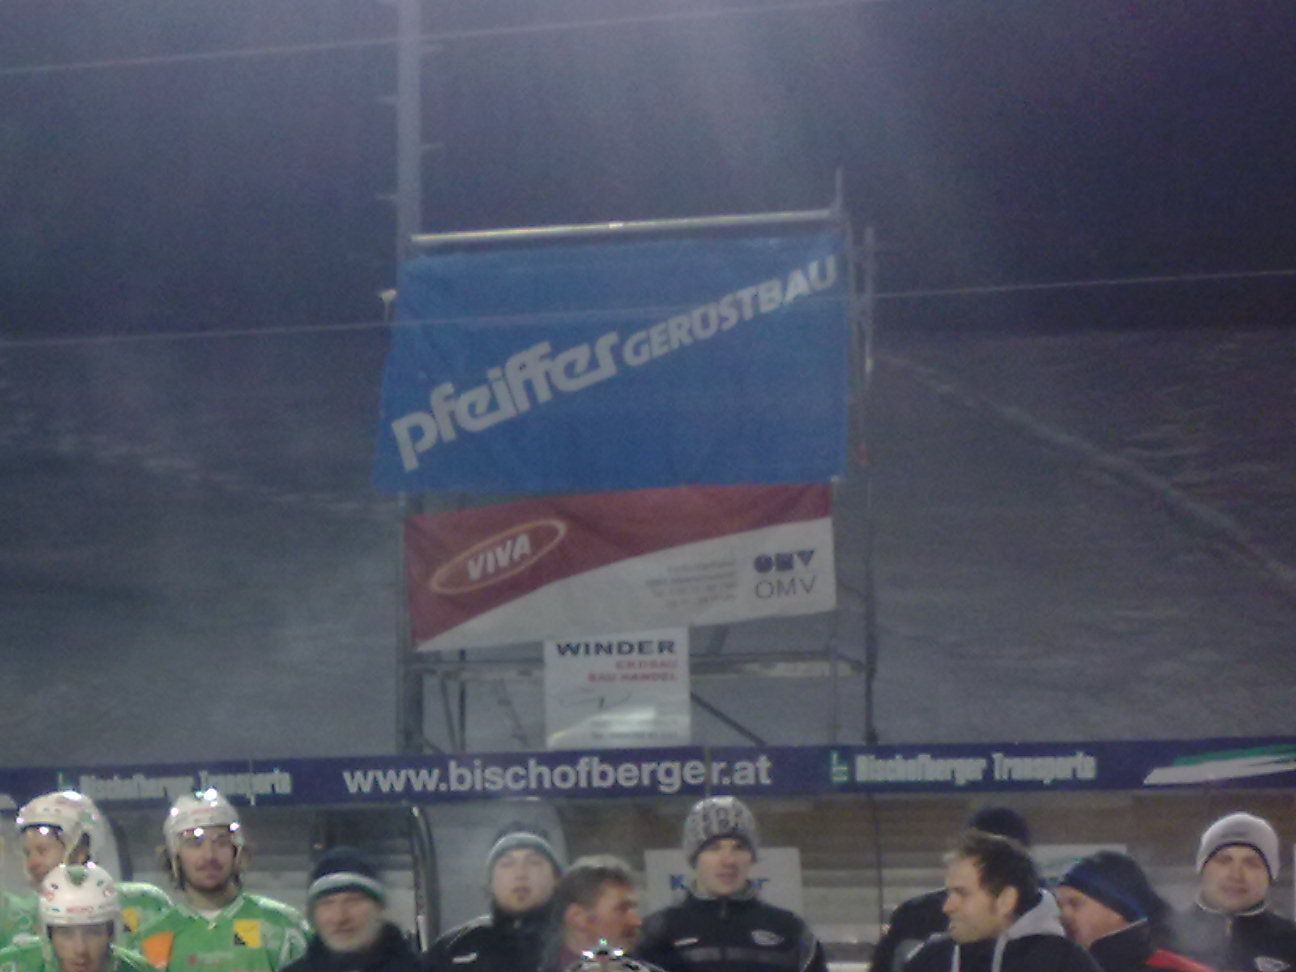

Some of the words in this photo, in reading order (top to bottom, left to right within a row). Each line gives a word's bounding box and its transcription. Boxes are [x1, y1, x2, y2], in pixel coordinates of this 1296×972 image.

[391, 331, 620, 472] pfeiffer
[467, 533, 531, 581] VIVA
[755, 574, 816, 600] OMV
[556, 640, 675, 656] WINDER
[342, 754, 772, 794] www.bischofberger.at
